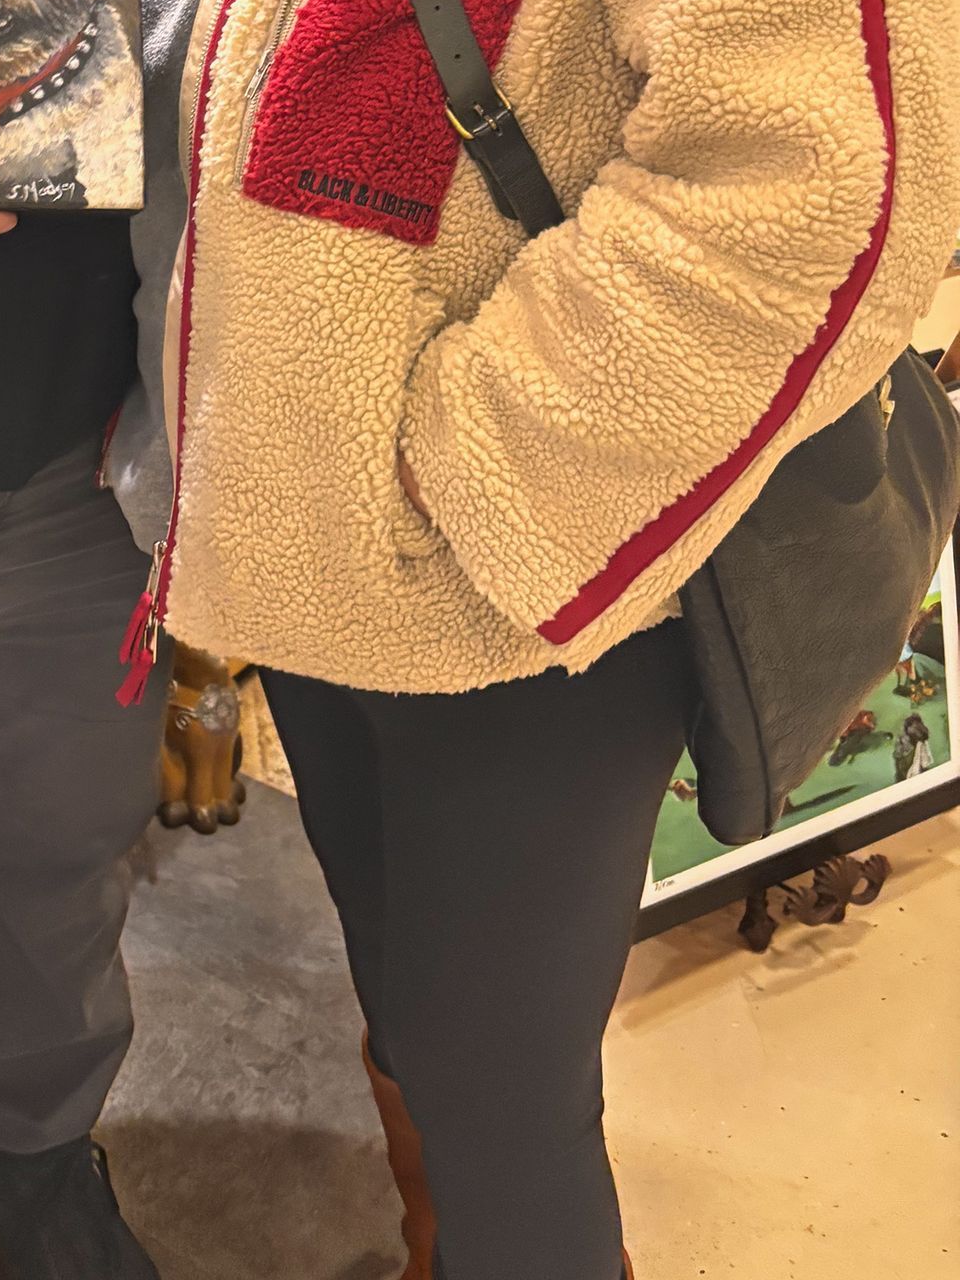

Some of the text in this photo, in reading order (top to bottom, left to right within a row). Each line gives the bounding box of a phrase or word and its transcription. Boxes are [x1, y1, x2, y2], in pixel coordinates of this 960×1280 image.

[297, 169, 433, 225] BLACK & LIBERTY
